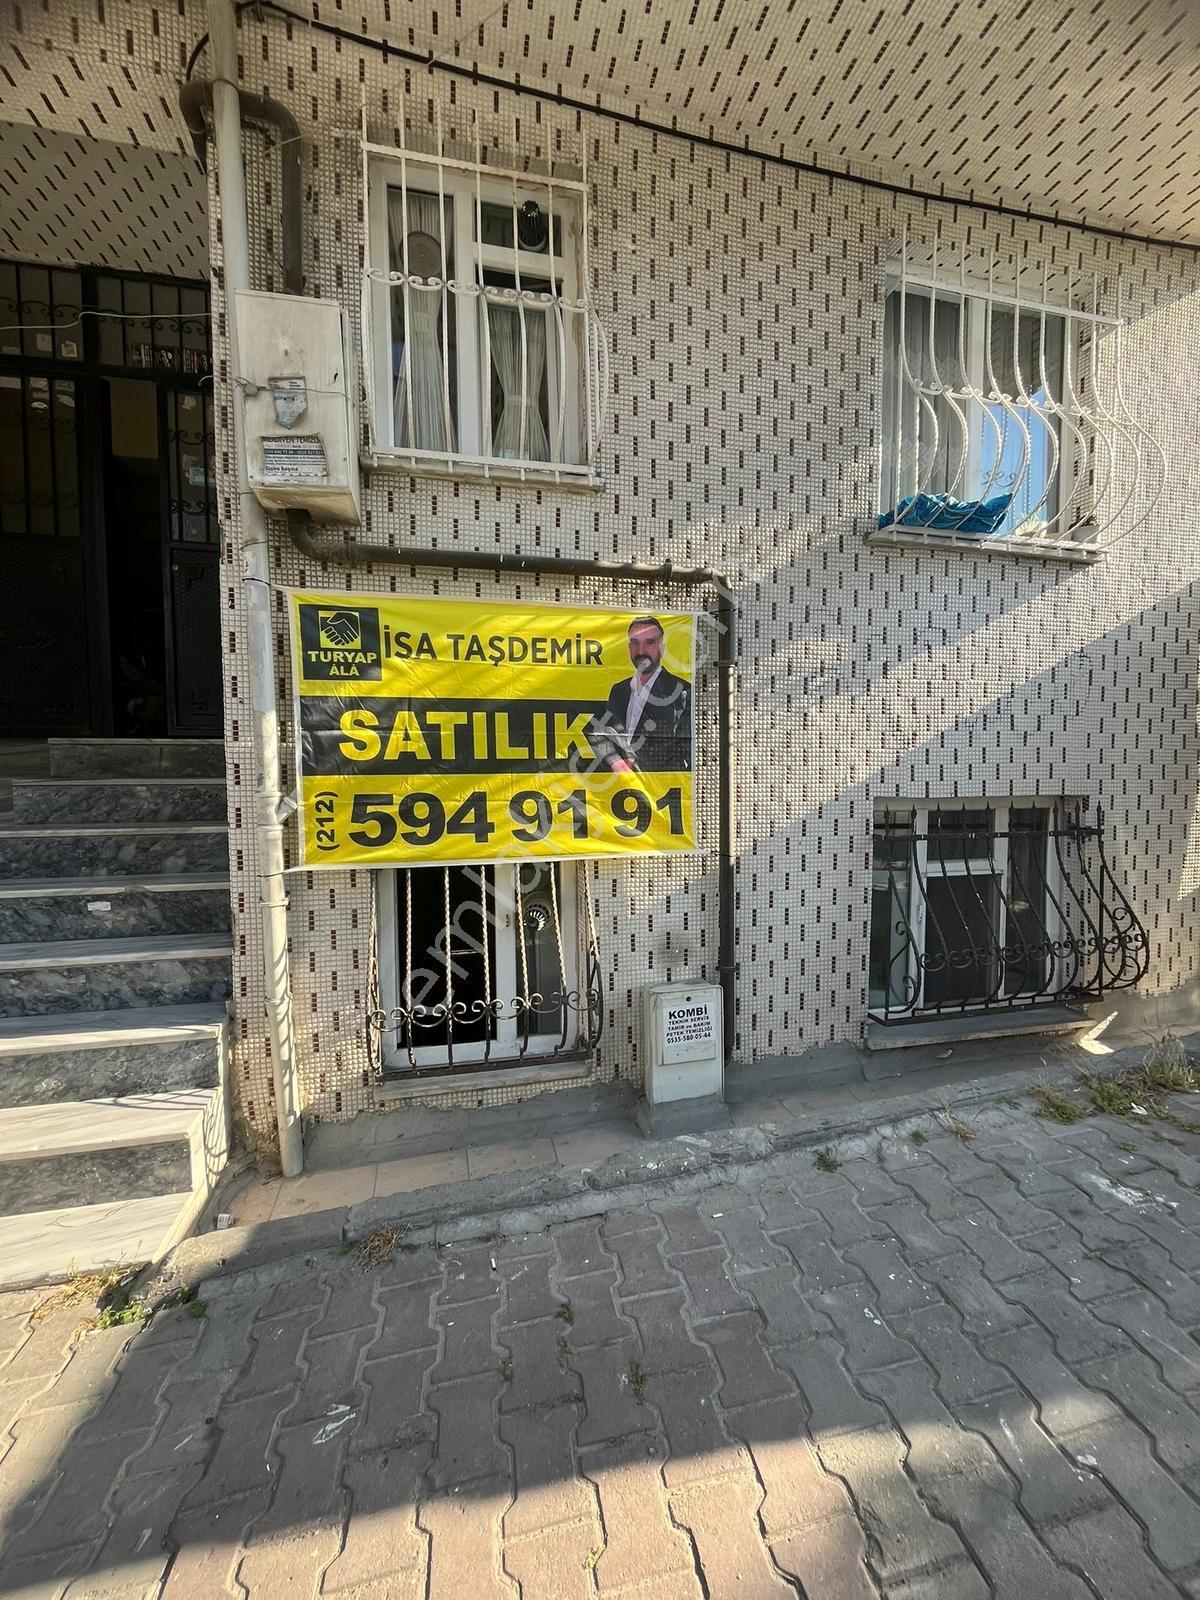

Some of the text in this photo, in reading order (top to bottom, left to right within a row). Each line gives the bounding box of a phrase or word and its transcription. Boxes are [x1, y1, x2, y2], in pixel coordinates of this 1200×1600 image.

[307, 650, 377, 664] TURYAP
[384, 625, 604, 667] İSA TAŞDEMİR
[338, 709, 597, 761] SATILIK
[314, 790, 340, 851] (212)
[348, 787, 685, 847] 594 91 91
[669, 1004, 707, 1019] KOMBİ
